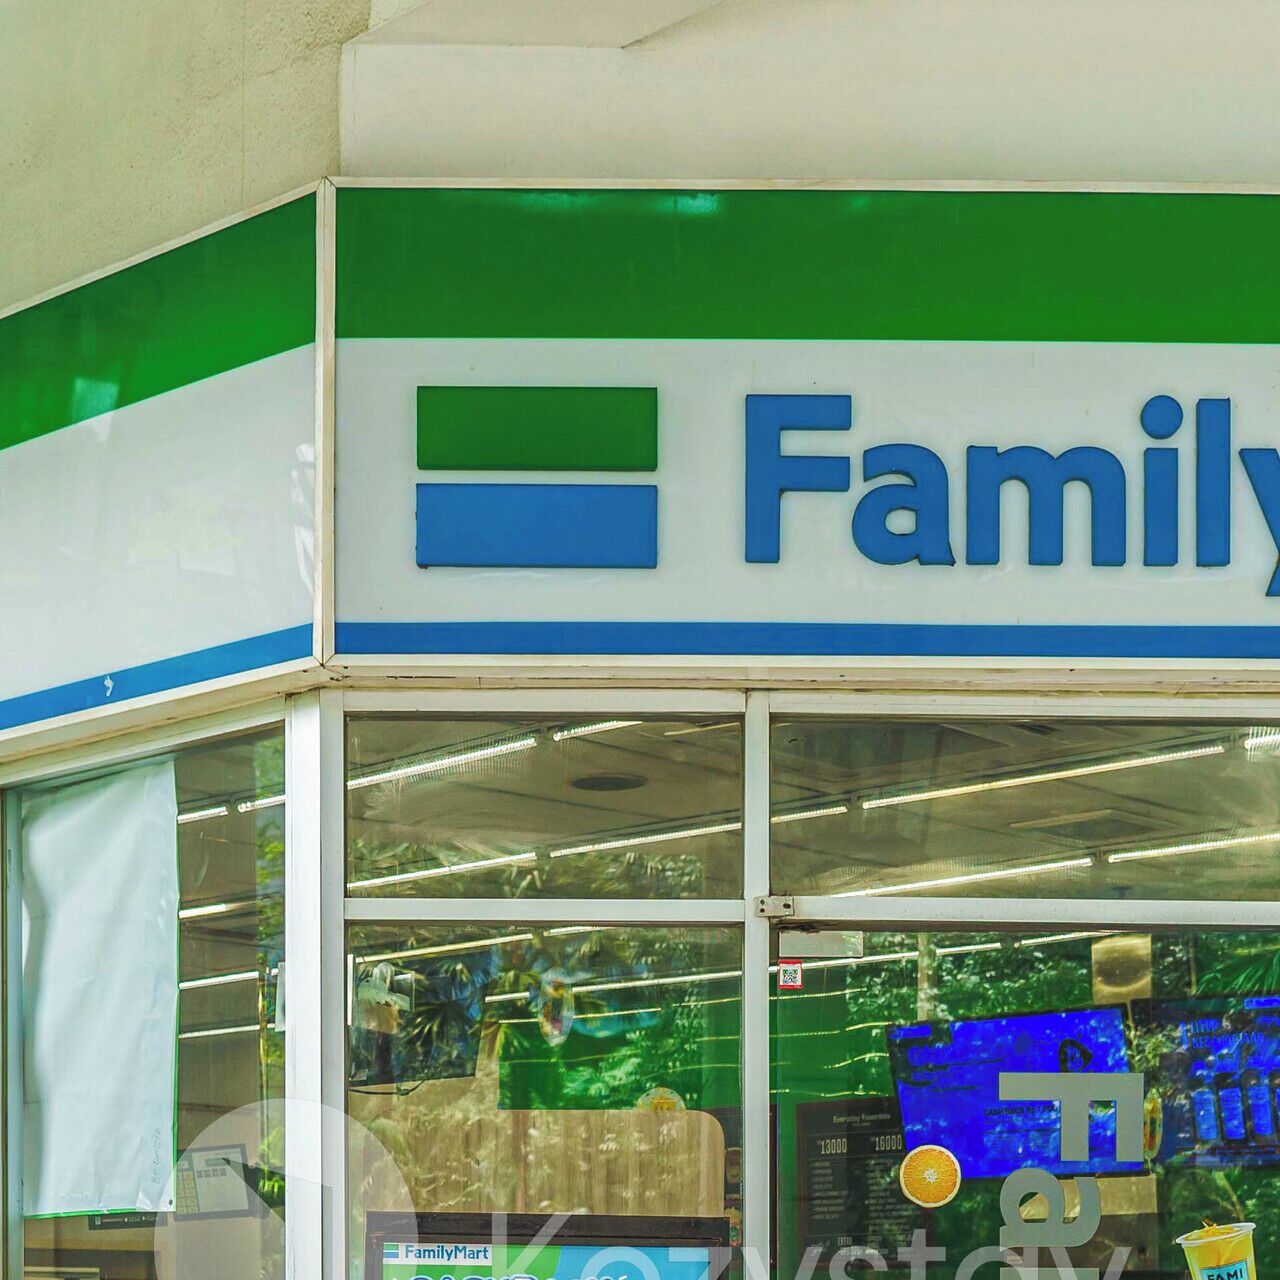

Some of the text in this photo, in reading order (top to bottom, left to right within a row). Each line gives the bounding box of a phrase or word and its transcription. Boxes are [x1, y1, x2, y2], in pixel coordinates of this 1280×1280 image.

[821, 1139, 847, 1154] 13000
[875, 1135, 902, 1150] 16000
[405, 1245, 488, 1261] FamilyMart
